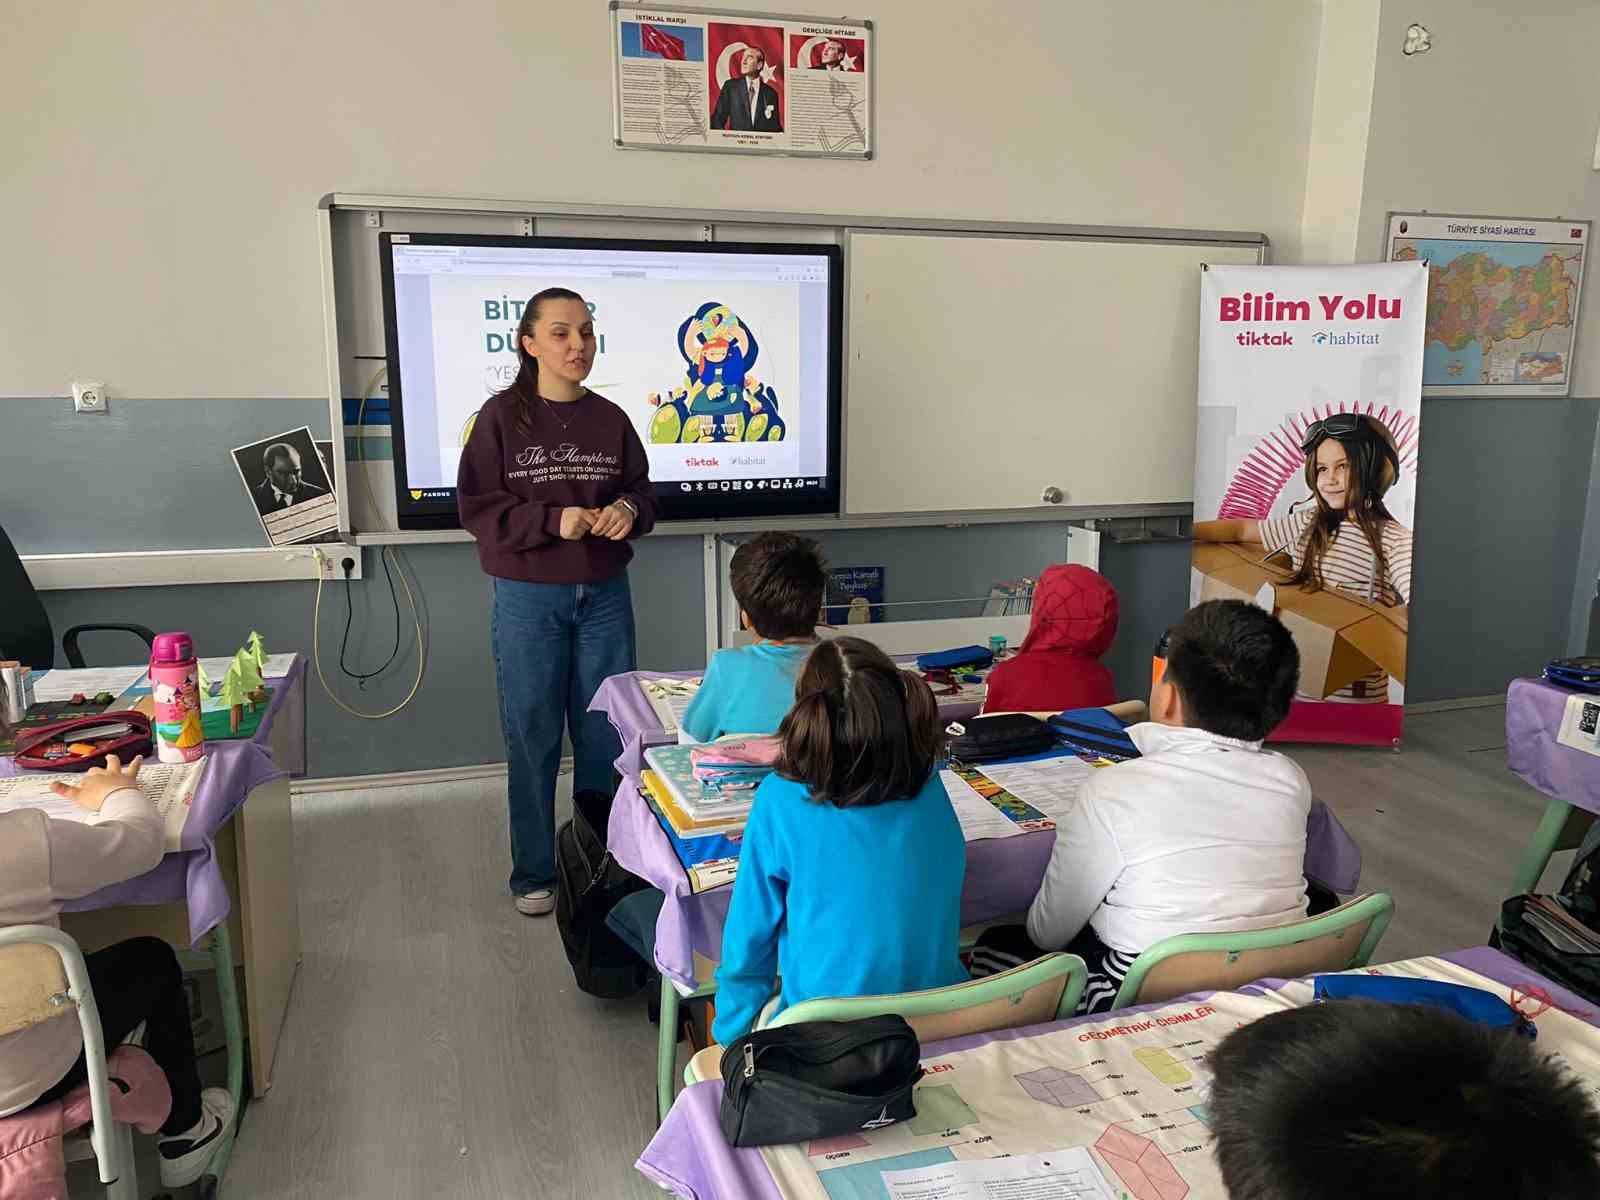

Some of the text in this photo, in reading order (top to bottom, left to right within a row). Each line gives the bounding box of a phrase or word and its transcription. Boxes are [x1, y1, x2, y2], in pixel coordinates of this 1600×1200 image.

[1447, 223, 1478, 234] TÜRKİYE
[1479, 224, 1503, 236] SİYASİ
[1219, 292, 1402, 322] Bilim Yolu
[1236, 331, 1293, 346] tiktak
[1329, 331, 1380, 345] habitat
[516, 443, 617, 466] The Hamptons
[686, 456, 719, 467] tiktak
[508, 471, 528, 479] EVERY
[529, 468, 548, 476] GOOD
